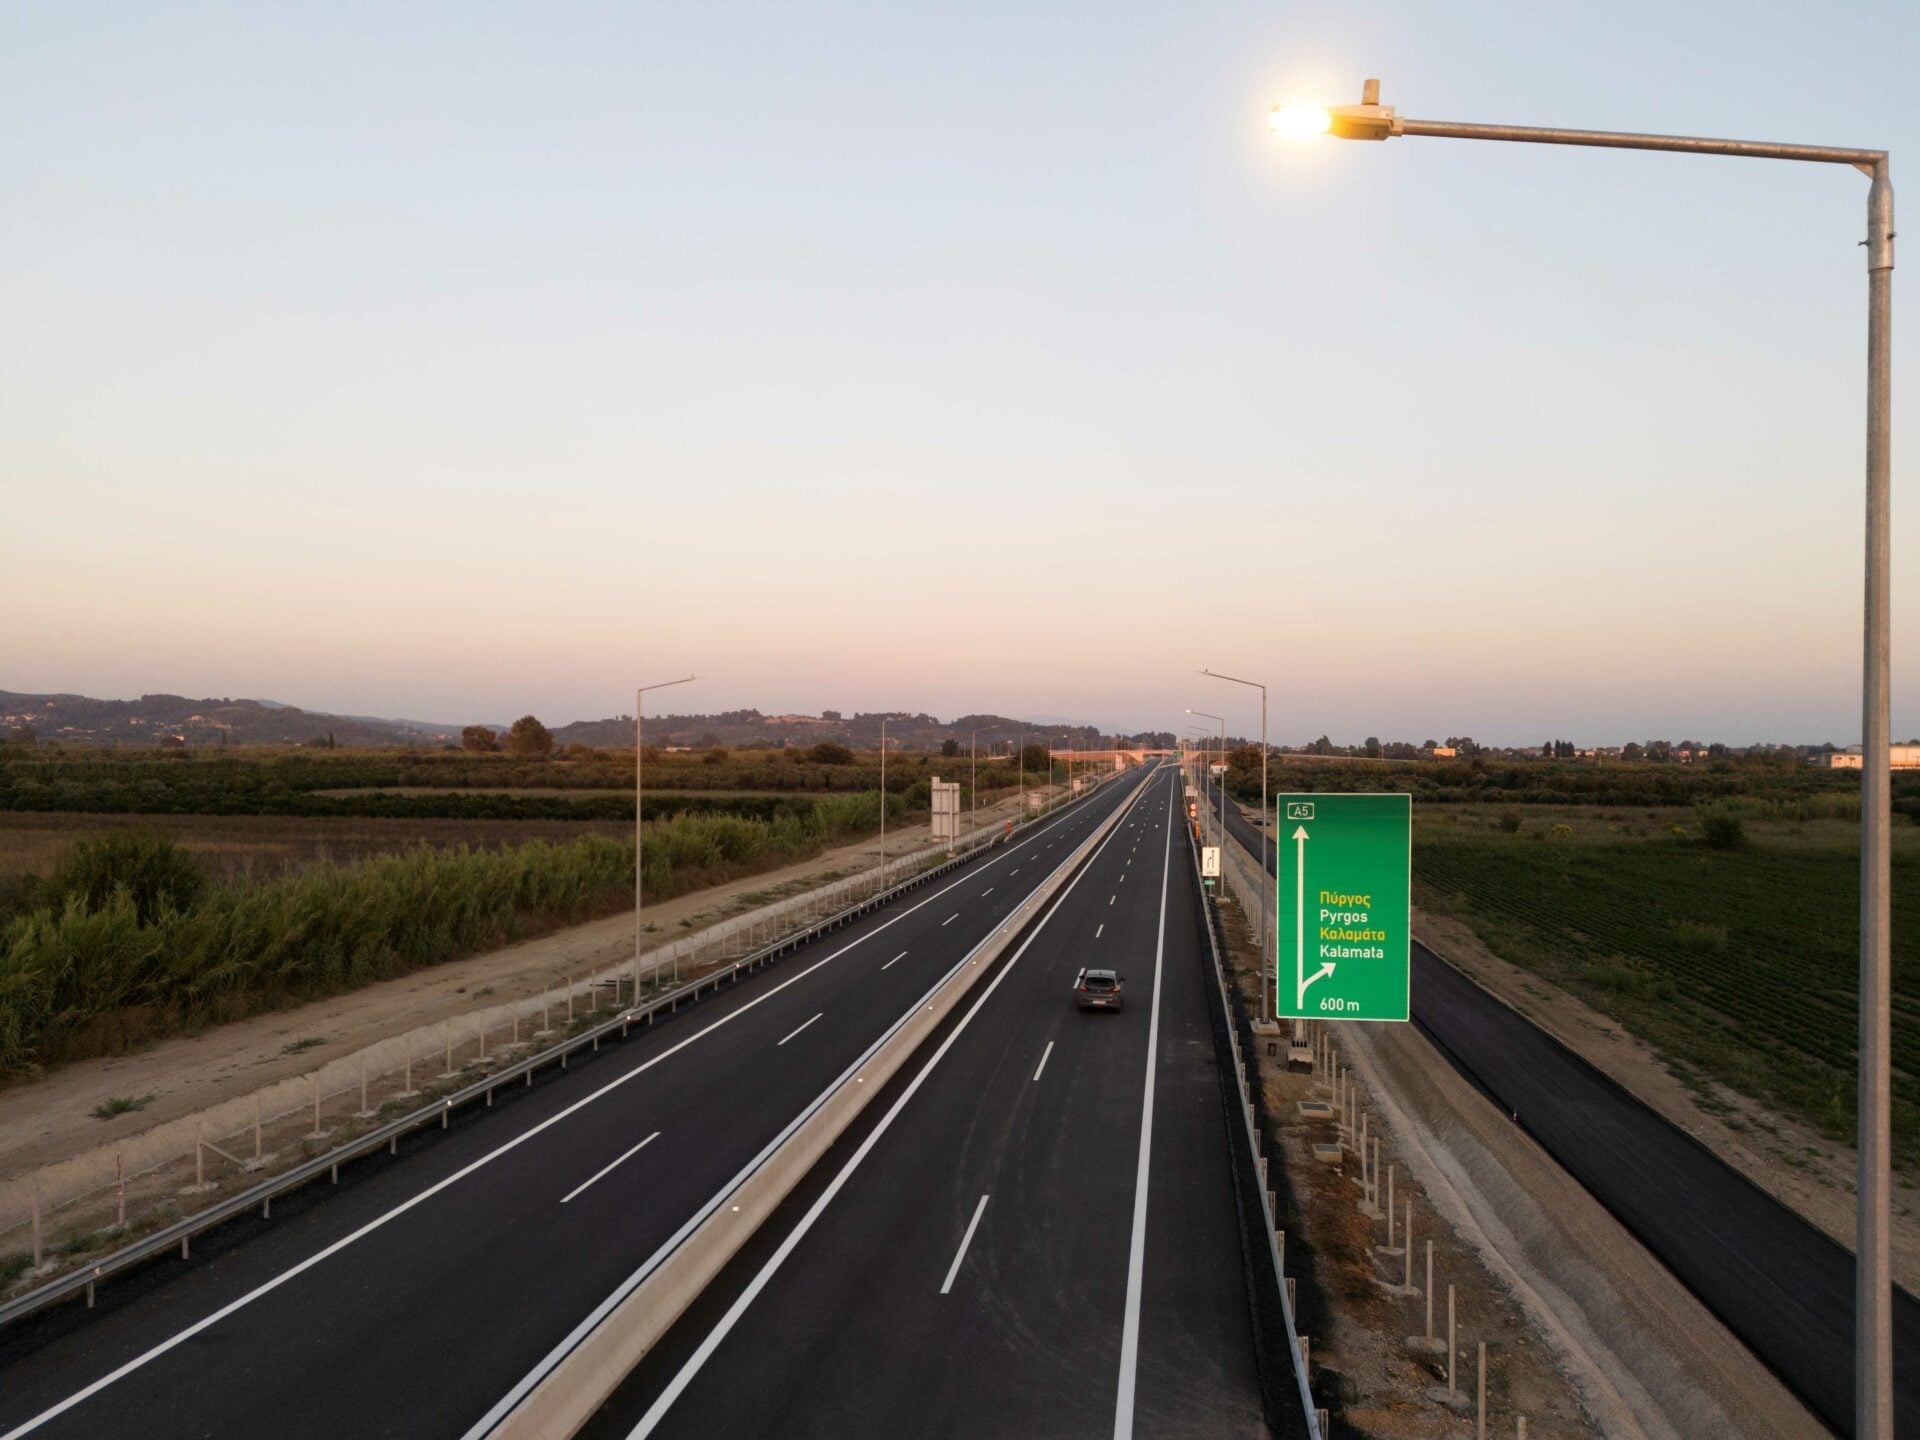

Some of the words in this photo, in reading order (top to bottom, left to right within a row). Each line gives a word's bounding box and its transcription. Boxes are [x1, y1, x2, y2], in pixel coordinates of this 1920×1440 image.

[1294, 805, 1309, 817] A5
[1320, 891, 1371, 908] Πύργος
[1320, 909, 1368, 925] Pyrgos
[1320, 927, 1385, 943] Καλαμάτα
[1320, 945, 1384, 958] Kalamata
[1320, 998, 1343, 1011] 600
[1347, 1001, 1359, 1011] m
